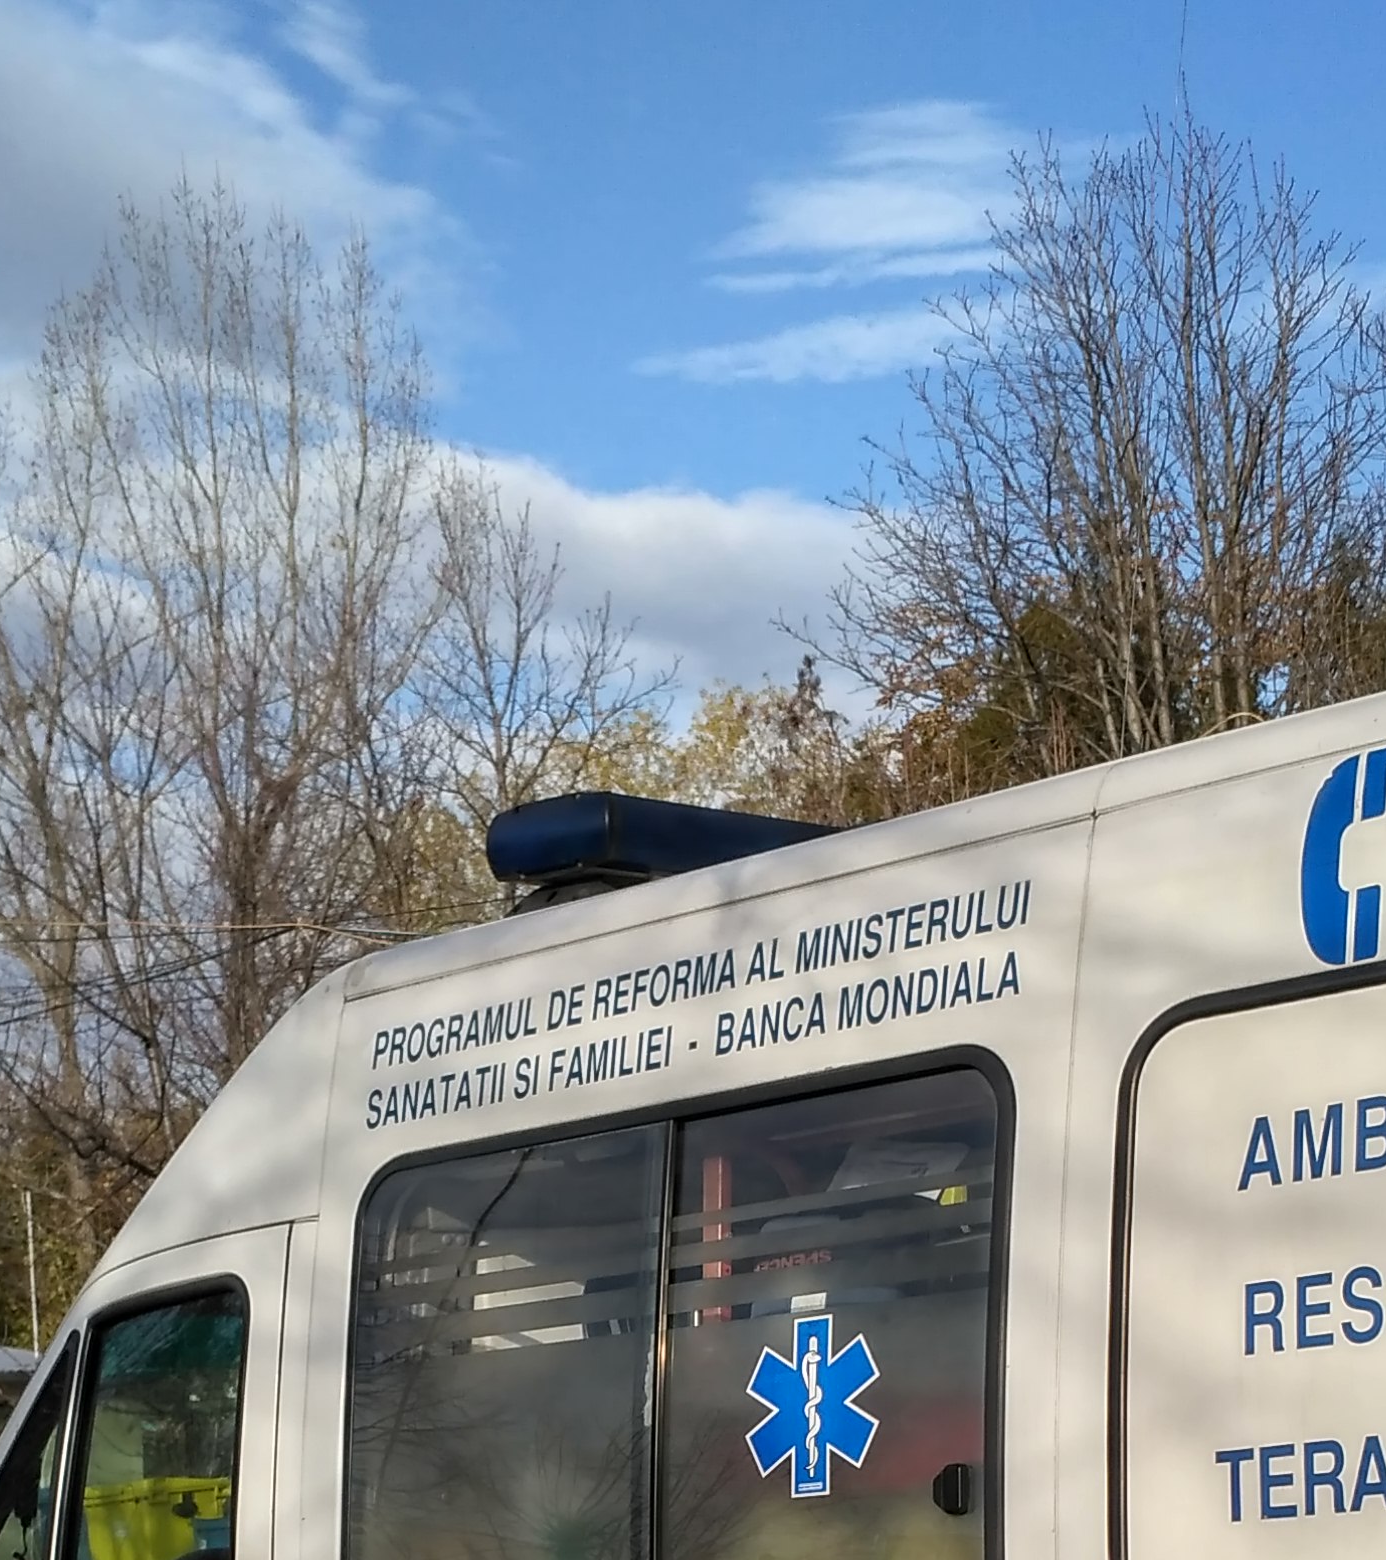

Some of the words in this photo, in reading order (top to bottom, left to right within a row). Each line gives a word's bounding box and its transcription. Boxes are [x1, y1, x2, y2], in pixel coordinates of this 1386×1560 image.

[365, 1061, 505, 1130] SANATATII
[513, 1055, 539, 1100] SI
[548, 1026, 672, 1093] FAMILIEI
[714, 990, 827, 1057] BANCA
[837, 951, 1021, 1031] MONDIALA
[372, 996, 537, 1071] PROGRAMUL
[547, 984, 586, 1032] DE
[592, 950, 736, 1022] REFORMA
[745, 937, 785, 987] AL
[795, 880, 1031, 974] MINISTERULUI
